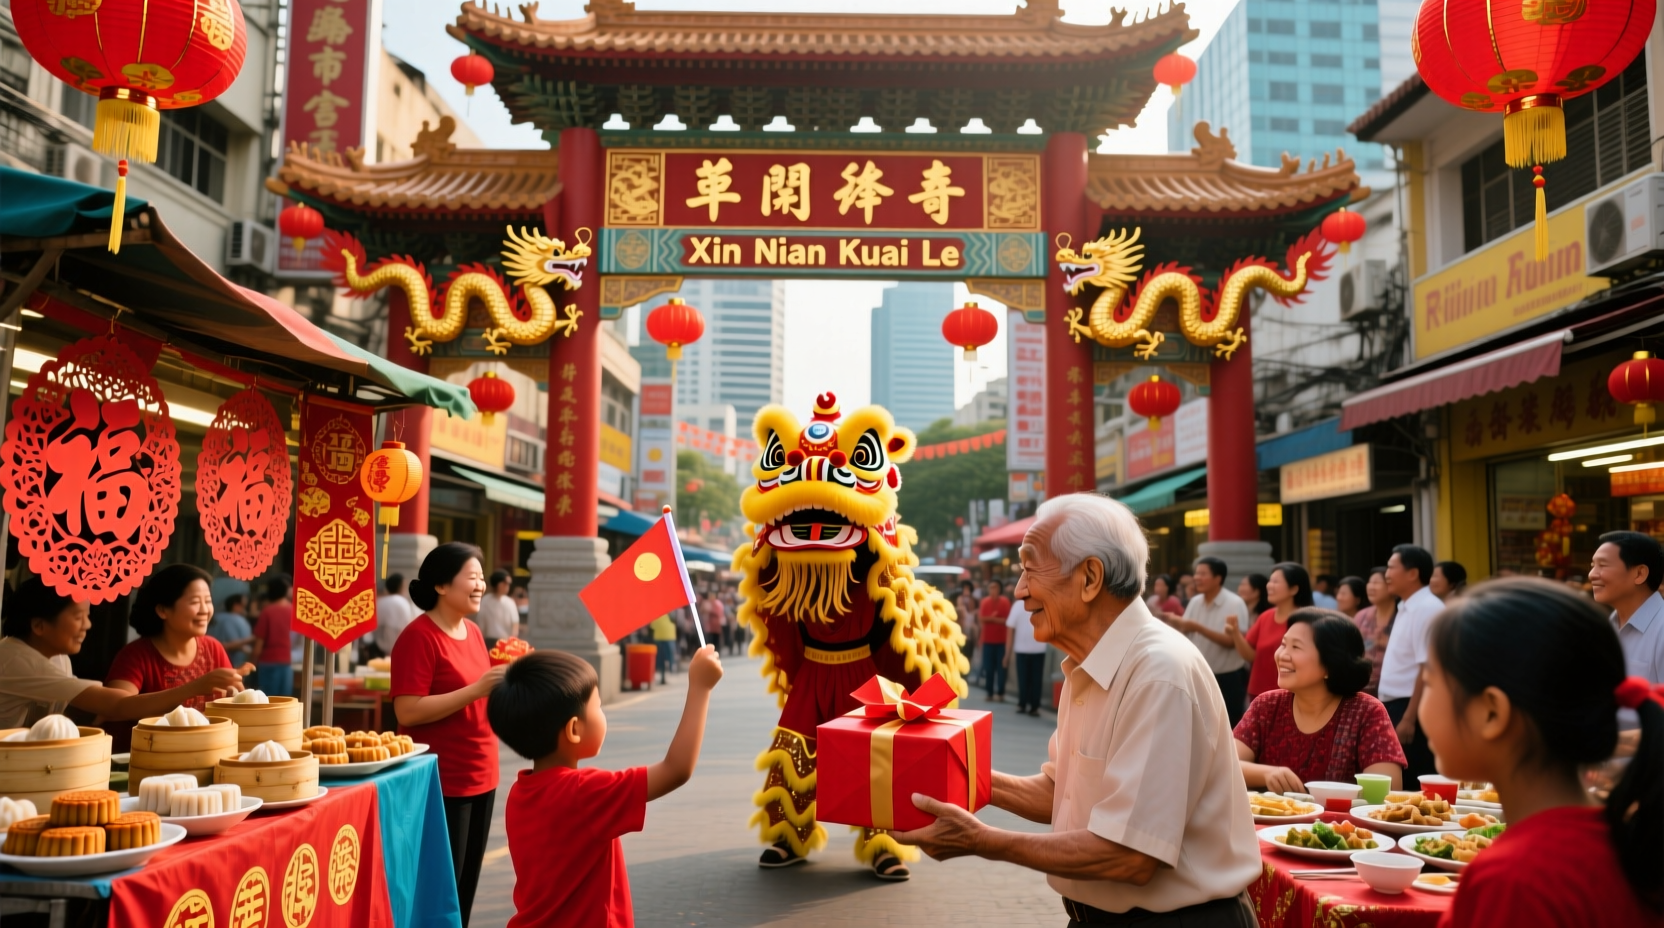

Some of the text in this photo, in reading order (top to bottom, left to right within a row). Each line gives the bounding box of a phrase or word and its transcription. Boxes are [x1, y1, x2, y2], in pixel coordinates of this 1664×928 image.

[688, 236, 960, 267] Xin Nian Kuai Le
[46, 388, 151, 543] 福
[218, 425, 275, 533] 福
